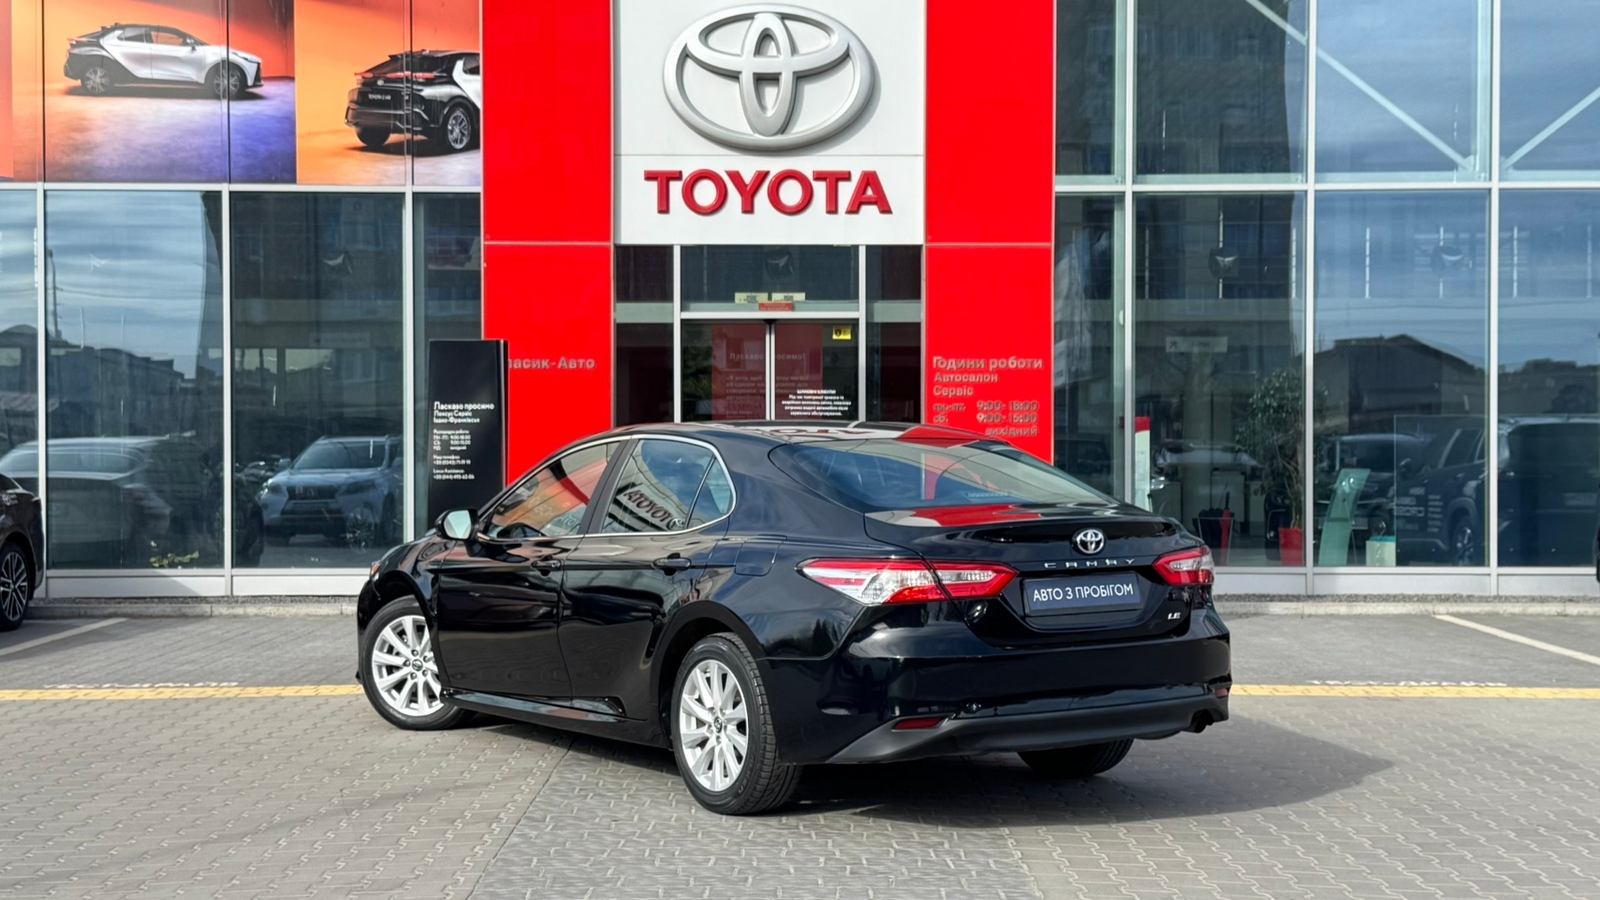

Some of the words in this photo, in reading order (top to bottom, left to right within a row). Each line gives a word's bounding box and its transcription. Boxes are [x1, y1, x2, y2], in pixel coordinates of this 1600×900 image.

[644, 169, 893, 216] TOYOTA
[933, 356, 985, 370] Години
[989, 356, 1042, 372] роботи
[934, 373, 998, 382] Автосалон
[933, 385, 974, 398] Сервіс
[434, 401, 464, 410] Ласкаво
[986, 426, 1038, 436] вихідний
[1044, 558, 1135, 569] CAMRY
[1033, 588, 1064, 602] АВТО
[1066, 587, 1074, 600] З
[1075, 584, 1134, 598] ПРОБІГОМ
[1168, 612, 1180, 620] LE
